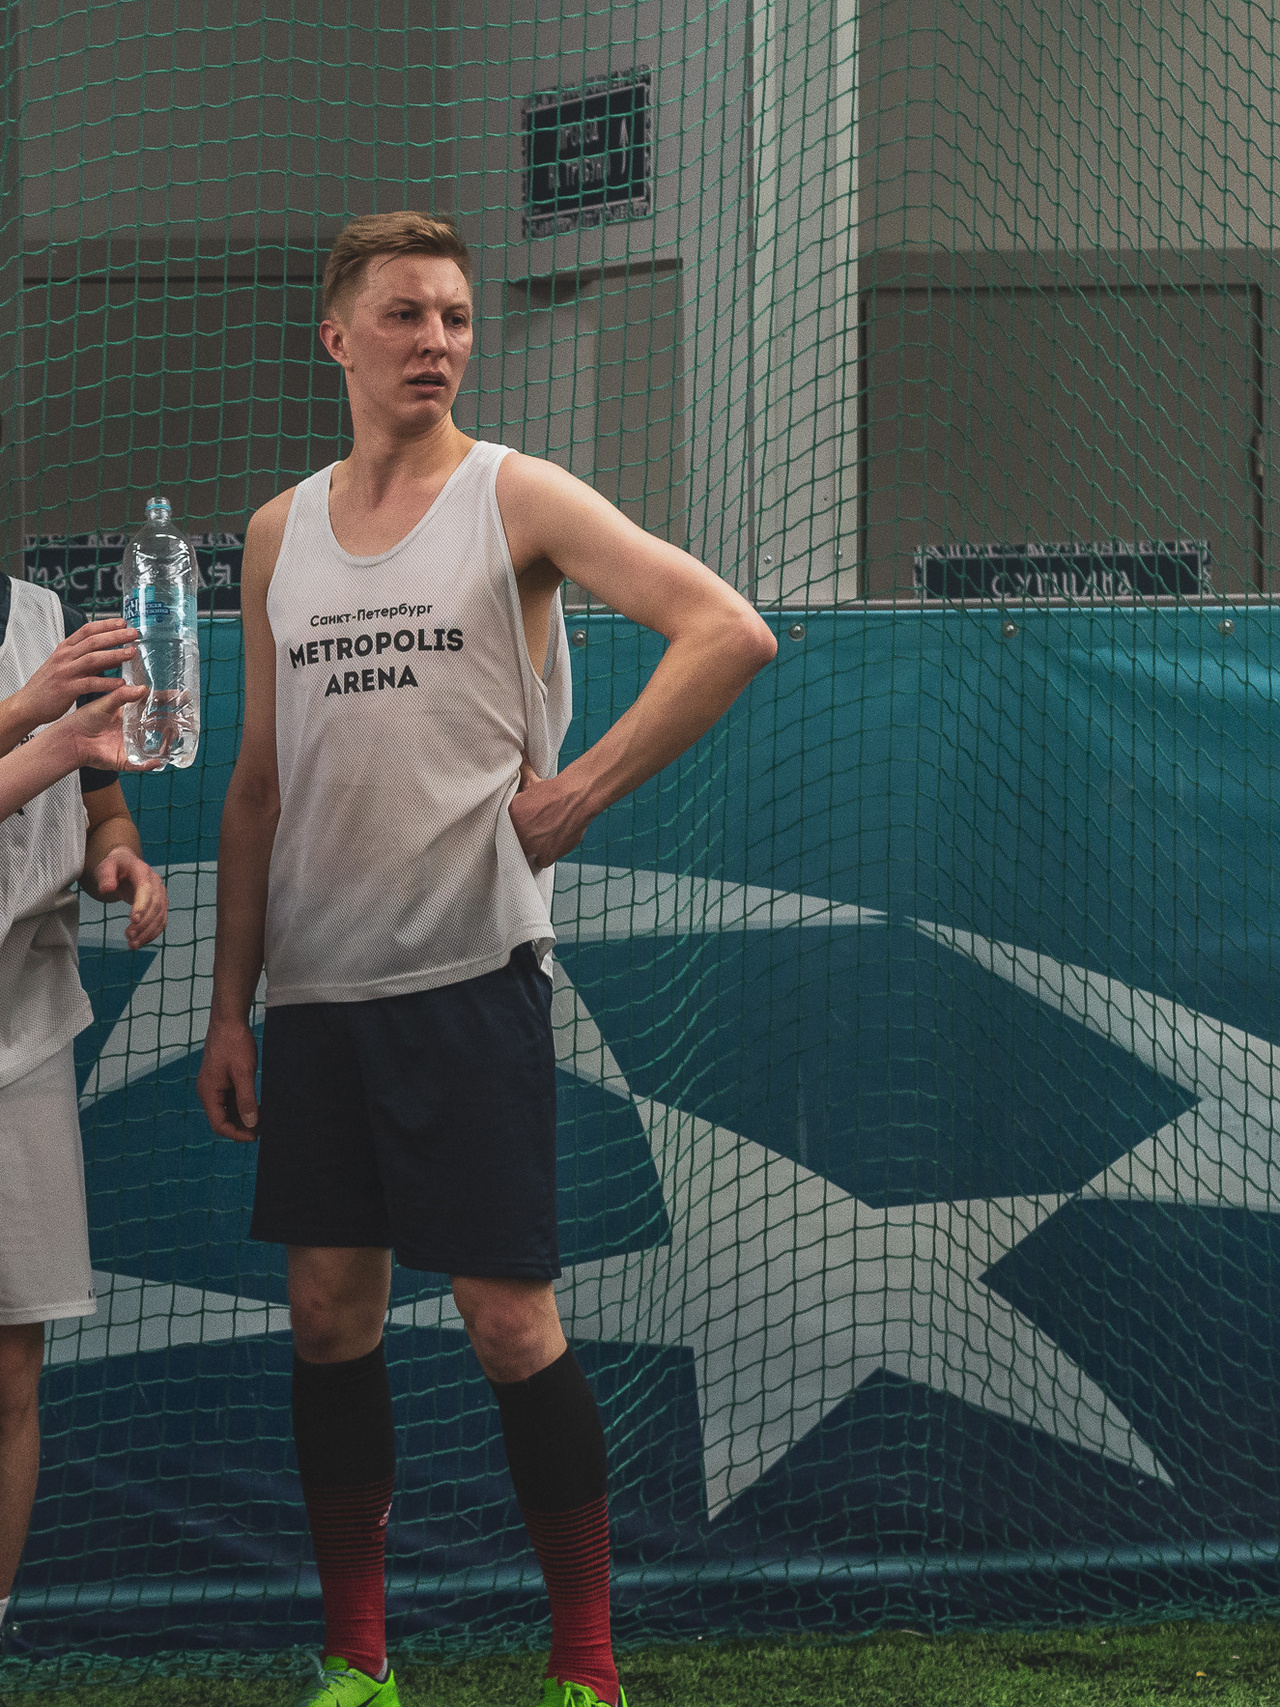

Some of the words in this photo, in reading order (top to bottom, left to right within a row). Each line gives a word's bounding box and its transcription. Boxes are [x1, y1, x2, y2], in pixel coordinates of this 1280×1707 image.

[310, 603, 433, 627] Санкт-Петербург
[289, 628, 464, 669] METROPOLIS
[324, 665, 419, 697] ARENA
